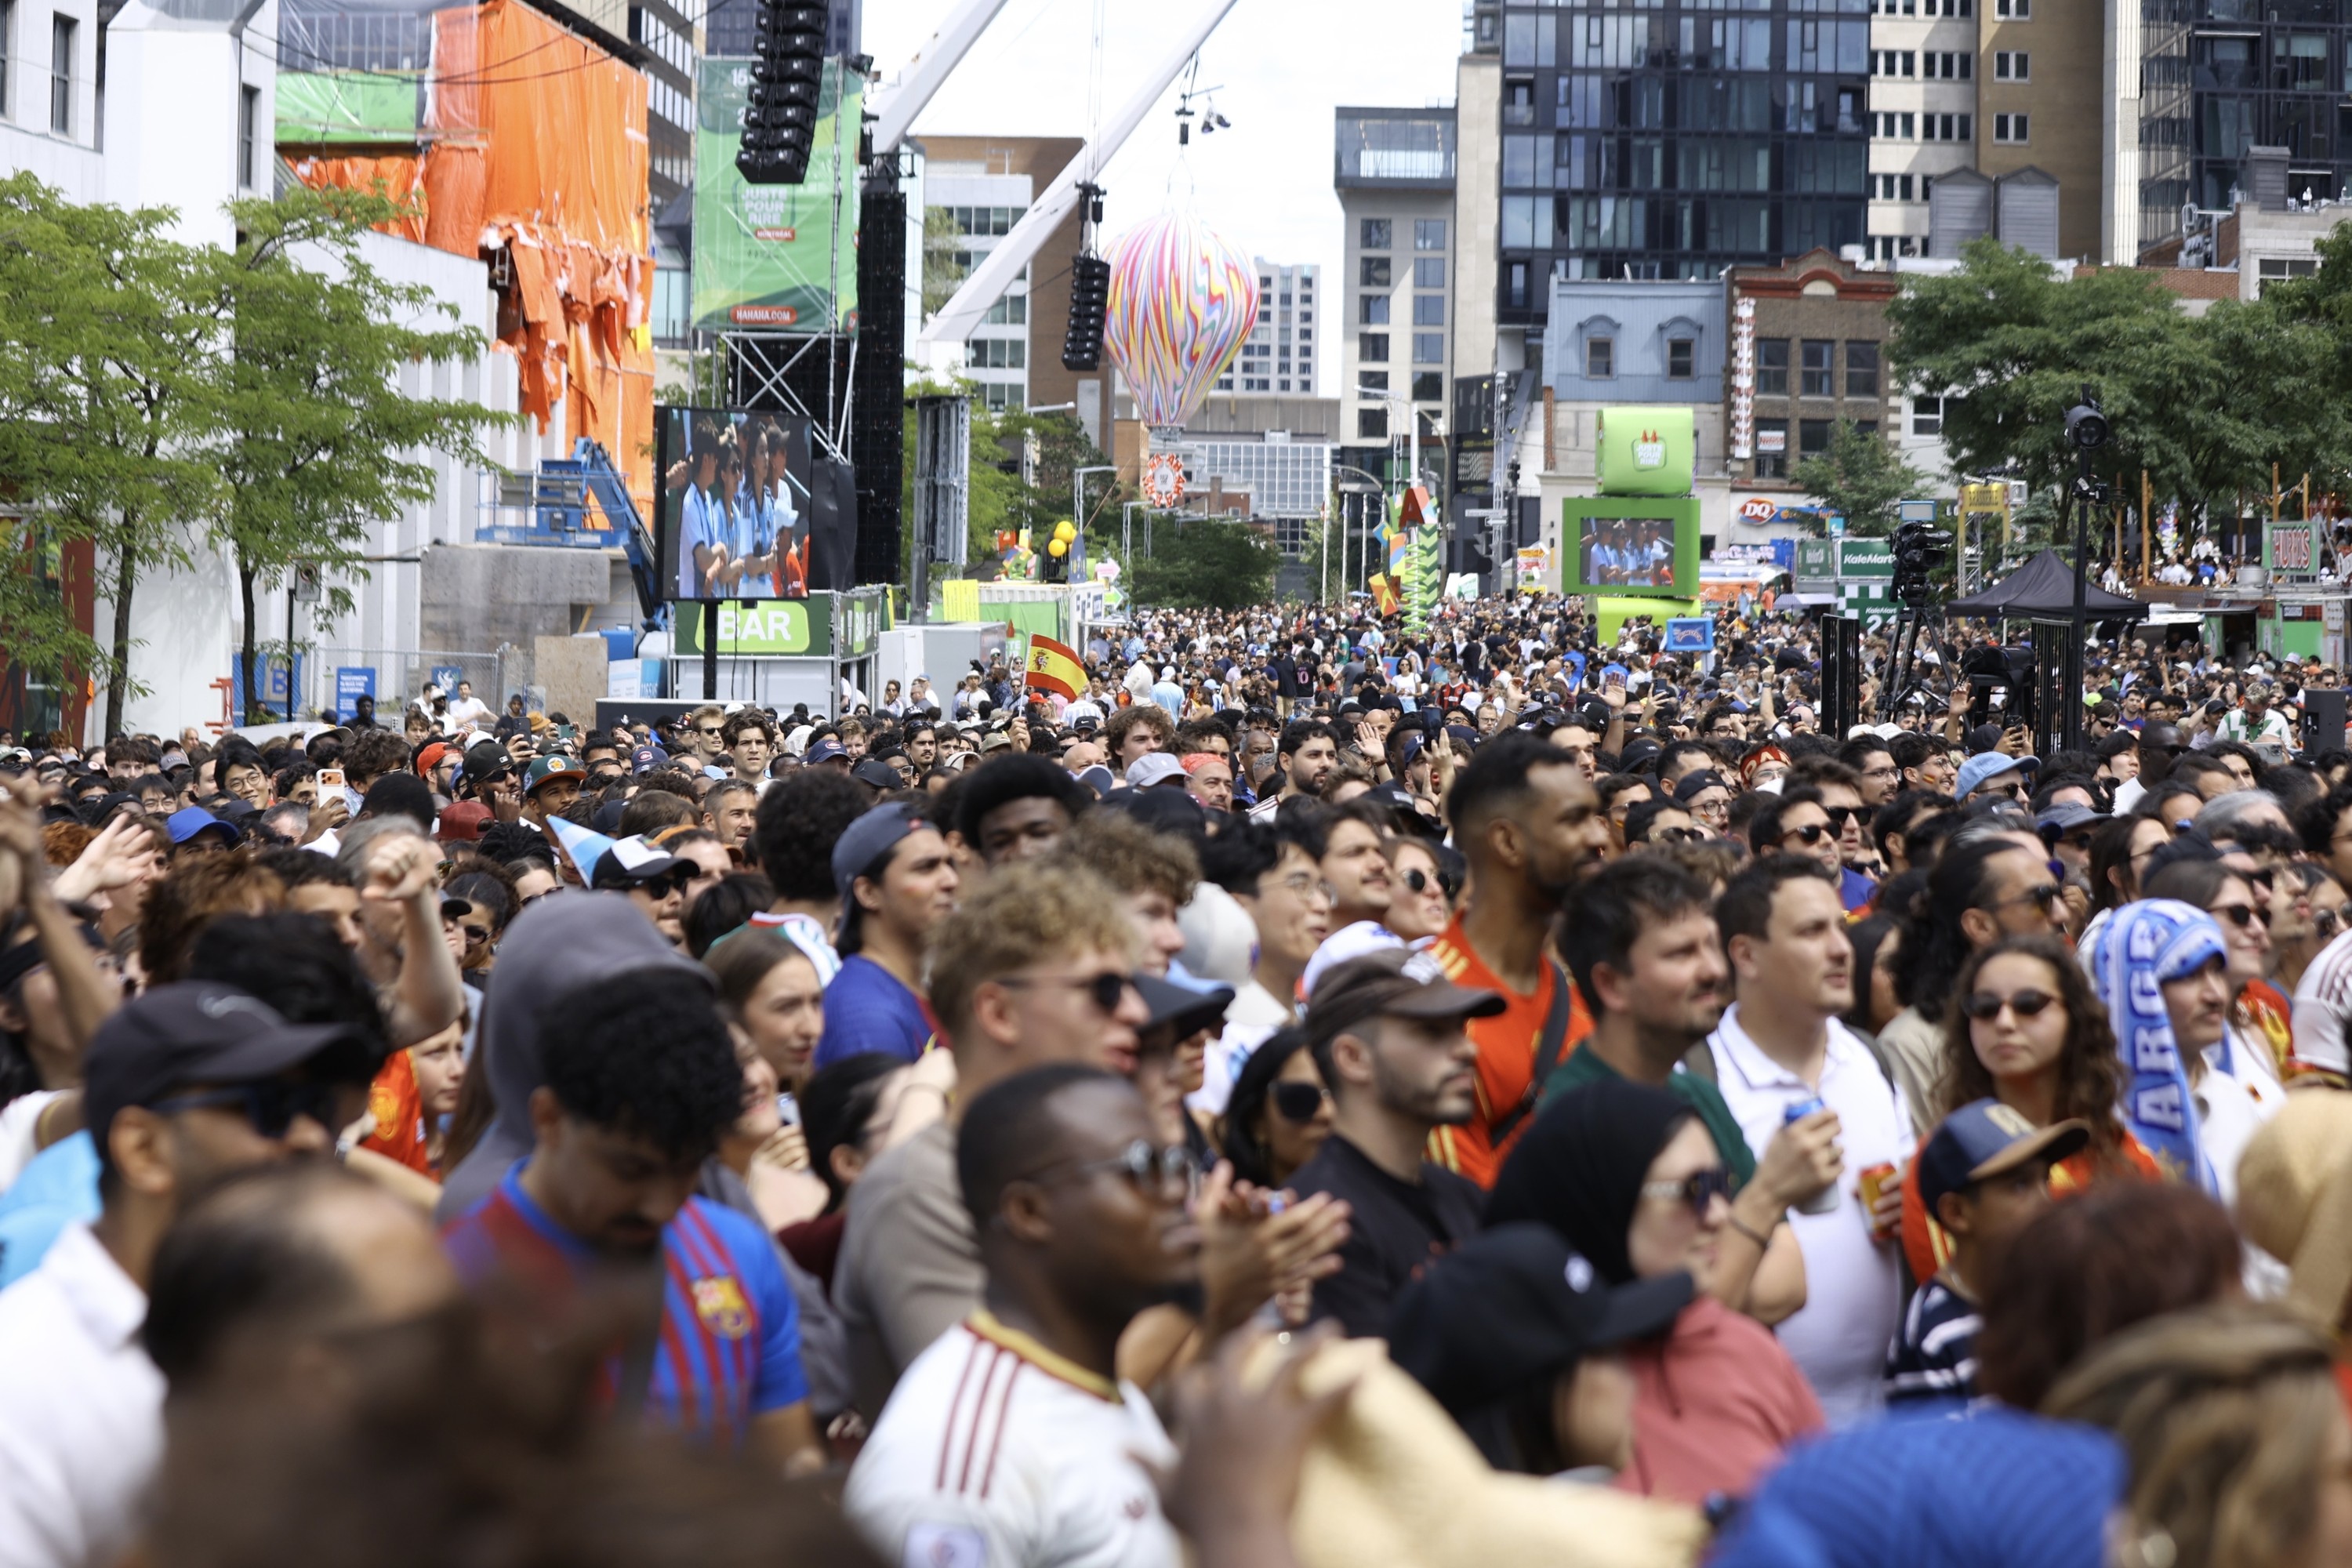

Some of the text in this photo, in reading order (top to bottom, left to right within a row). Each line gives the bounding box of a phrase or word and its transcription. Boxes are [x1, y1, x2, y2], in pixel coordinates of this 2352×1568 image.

[742, 187, 787, 200] JUSTE
[745, 200, 785, 212] POUR
[748, 212, 782, 225] RIRE
[735, 308, 790, 321] HAHAHA.COM
[1744, 502, 1770, 519] DQ
[717, 609, 793, 642] BAR
[1297, 670, 1308, 684] 10
